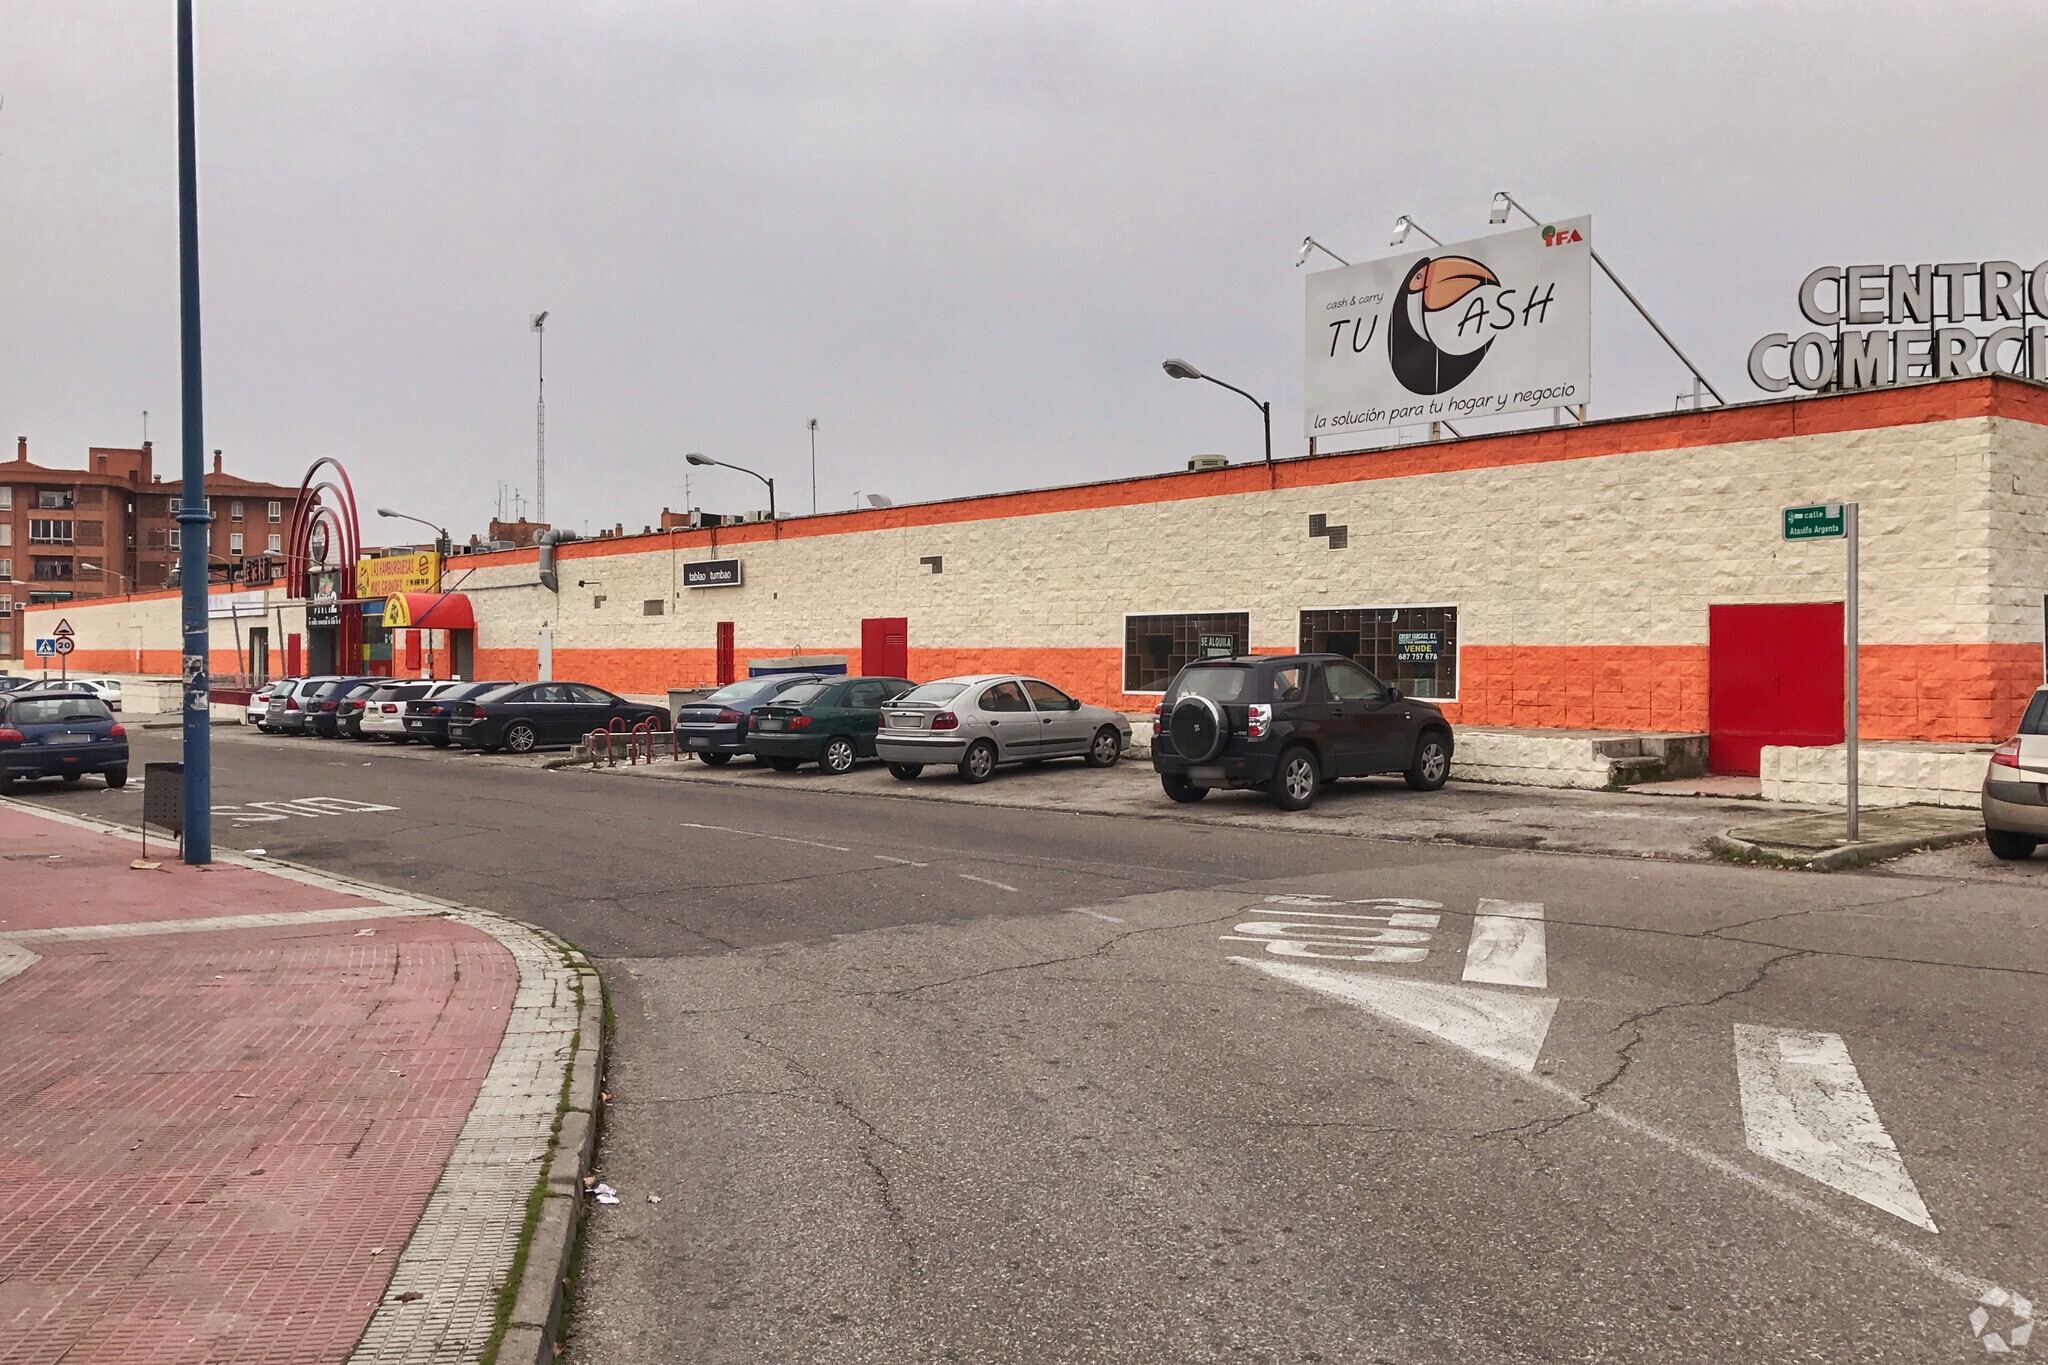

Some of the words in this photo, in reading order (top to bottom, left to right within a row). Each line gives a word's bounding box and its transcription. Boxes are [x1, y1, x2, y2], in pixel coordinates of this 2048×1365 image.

[1326, 297, 1348, 310] cash
[1349, 295, 1356, 306] &
[1358, 292, 1384, 305] carry
[1329, 314, 1378, 357] TU
[1313, 414, 1327, 429] la
[1331, 407, 1386, 427] solución
[1388, 403, 1424, 425] para
[1428, 399, 1444, 414] tu
[1448, 396, 1494, 415] hogar
[1495, 393, 1508, 411] y
[1513, 382, 1575, 407] negocio
[1804, 511, 1824, 519] calle
[1814, 524, 1839, 535] Argenta
[689, 571, 706, 581] tablao
[710, 569, 731, 580] tumbao
[1201, 636, 1208, 646] SE
[1404, 644, 1432, 653] VENDE
[1424, 652, 1438, 660] 678
